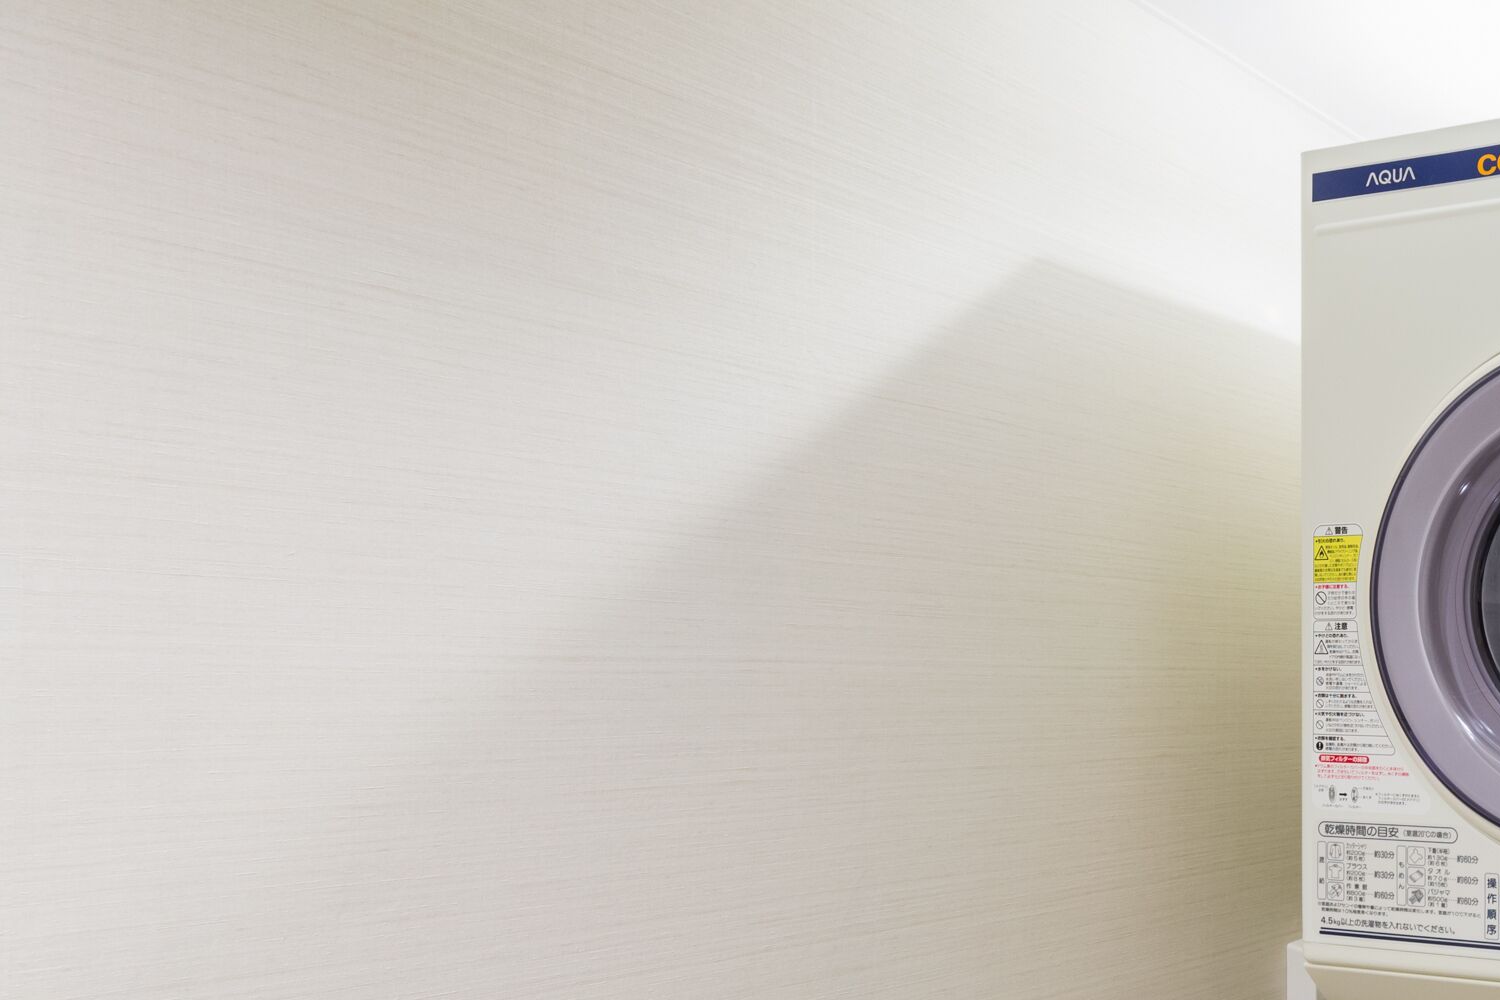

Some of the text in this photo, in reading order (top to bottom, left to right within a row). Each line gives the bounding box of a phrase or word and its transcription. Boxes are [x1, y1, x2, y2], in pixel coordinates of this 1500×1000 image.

[1365, 166, 1416, 187] AQUA
[1334, 622, 1348, 630] 注意
[1324, 823, 1399, 838] 乾燥時間の目安
[1374, 850, 1395, 860] 約30分
[1374, 871, 1395, 880] 約30分
[1486, 877, 1497, 936] 操作順序
